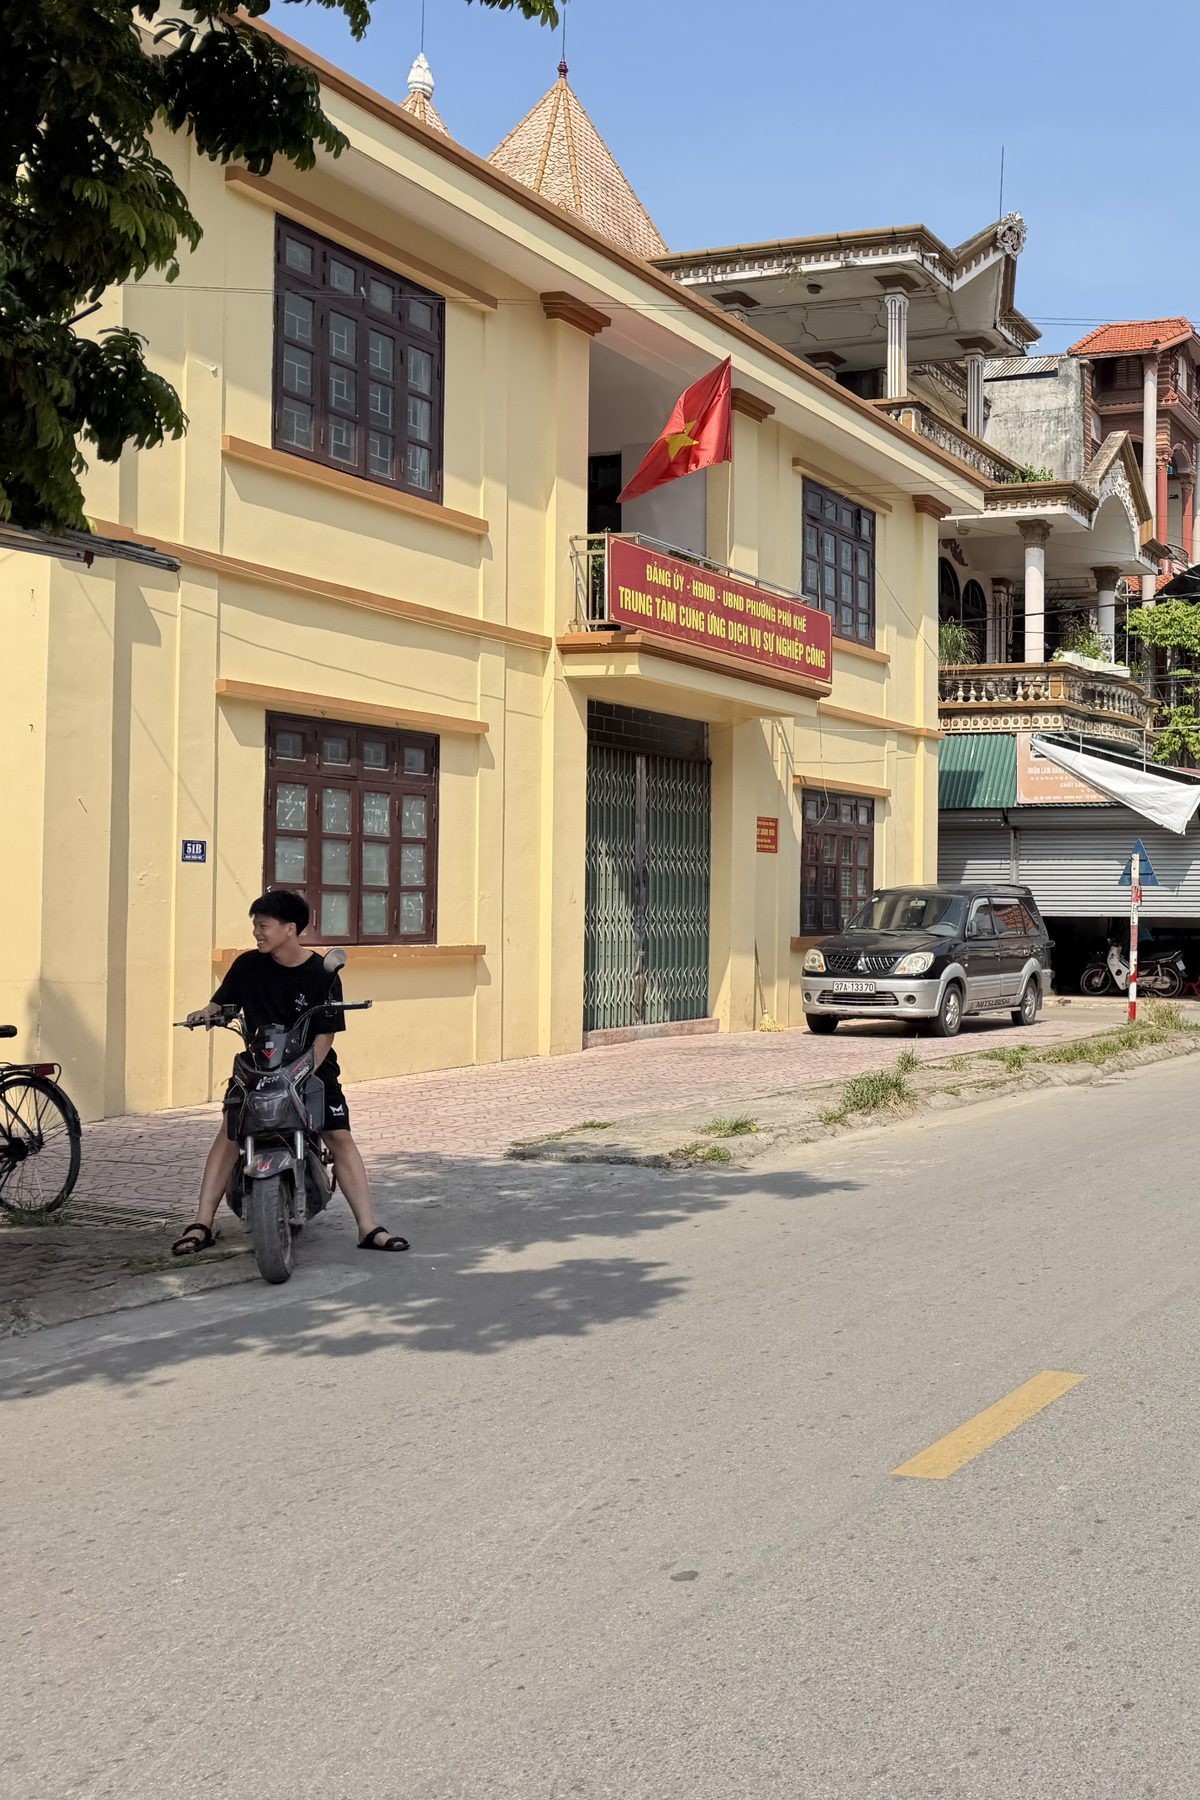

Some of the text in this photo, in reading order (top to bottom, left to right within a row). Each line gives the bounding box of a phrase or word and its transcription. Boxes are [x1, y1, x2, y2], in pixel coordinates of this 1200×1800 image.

[619, 586, 826, 669] TRUNG TÂM CUNG ỨNG DỊCH VỤ SỰ NGHIỆP CÔNG
[646, 561, 671, 588] ĐẢNG
[673, 569, 684, 592] ỦY
[692, 580, 715, 602] HĐND
[723, 590, 744, 612] UBND
[746, 598, 776, 622] PHƯỜNG
[777, 609, 792, 628] PHÙ
[186, 843, 202, 855] 51B
